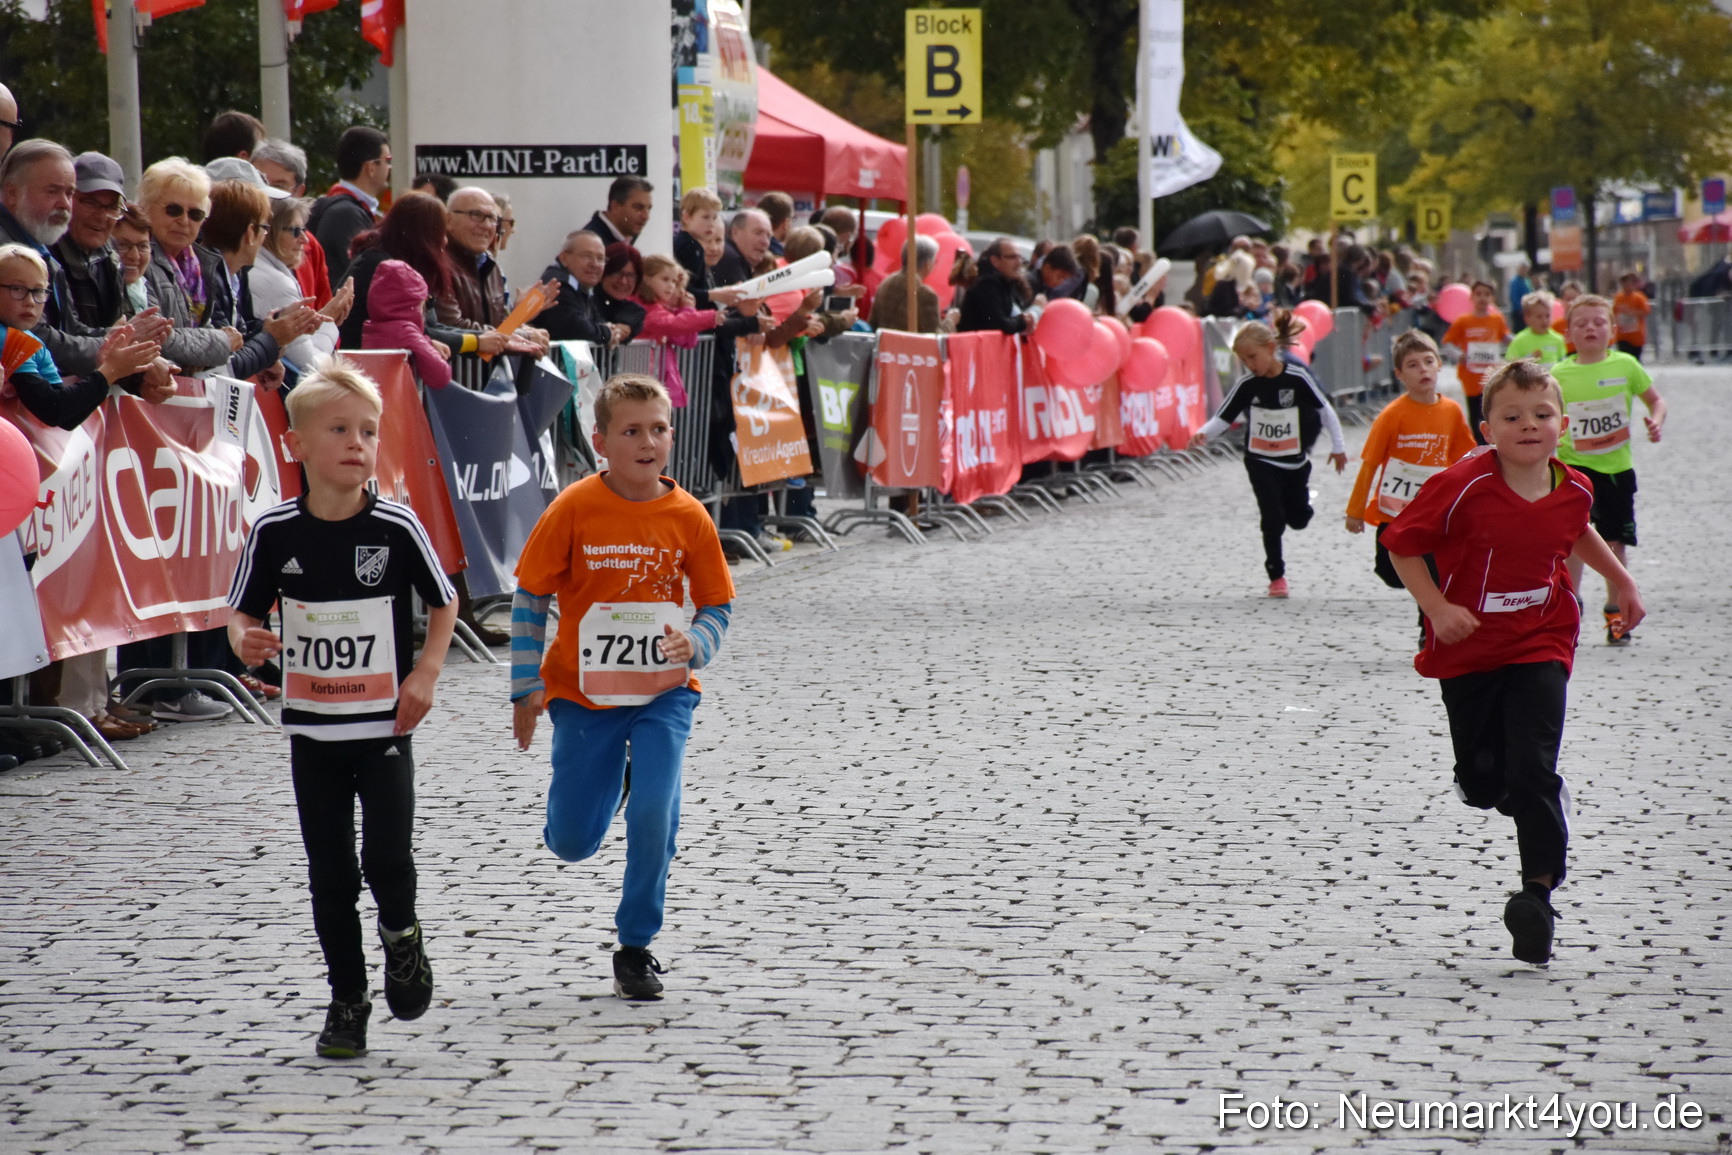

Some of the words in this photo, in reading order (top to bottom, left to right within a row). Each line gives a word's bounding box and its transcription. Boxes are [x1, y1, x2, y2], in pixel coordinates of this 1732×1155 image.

[915, 14, 972, 34] Block
[926, 44, 963, 98] B
[416, 148, 639, 174] www.MINI-Partl.de
[1342, 173, 1364, 205] C
[1425, 208, 1442, 231] D
[228, 385, 240, 422] swn
[1257, 422, 1291, 438] 7064
[1578, 412, 1622, 435] 7083
[61, 450, 92, 543] NEUE
[1392, 476, 1423, 499] 717
[583, 543, 655, 557] Neumarkter
[587, 557, 641, 572] tadtlauf
[1502, 595, 1532, 607] DEHN
[318, 611, 360, 623] BOCK
[297, 634, 376, 671] 7097
[597, 634, 668, 665] 7210
[311, 682, 366, 695] Korbinian
